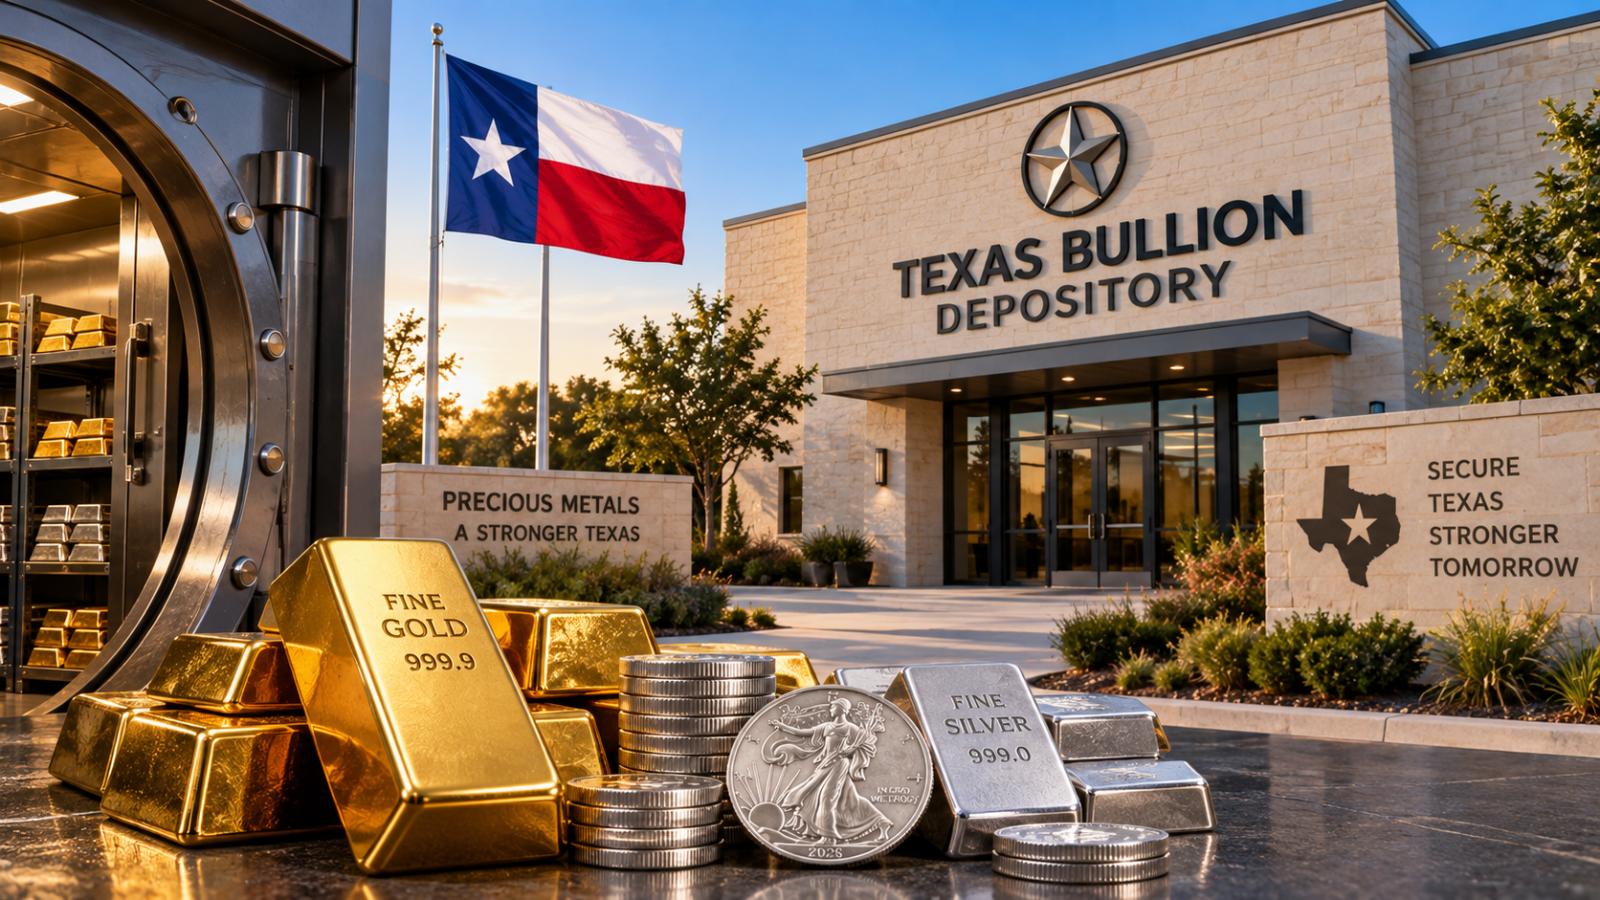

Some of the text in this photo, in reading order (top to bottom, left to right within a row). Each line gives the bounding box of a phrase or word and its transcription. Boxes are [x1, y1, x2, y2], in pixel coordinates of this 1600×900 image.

[893, 189, 1305, 298] TEXAS BULLION
[937, 260, 1231, 335] DEPOSITORY
[1428, 456, 1520, 480] SECURE
[442, 490, 640, 515] PRECIOUS METALS
[1428, 491, 1504, 513] TEXAS
[454, 524, 640, 542] A STRONGER TEXAS
[1429, 524, 1559, 545] STRONGER
[1429, 557, 1579, 577] TOMORROW
[382, 593, 446, 611] FINE
[382, 618, 468, 638] GOLD
[404, 652, 476, 671] 999.9
[951, 694, 1006, 710] FINE
[944, 716, 1032, 735] SILVER
[968, 746, 1031, 764] 999.0
